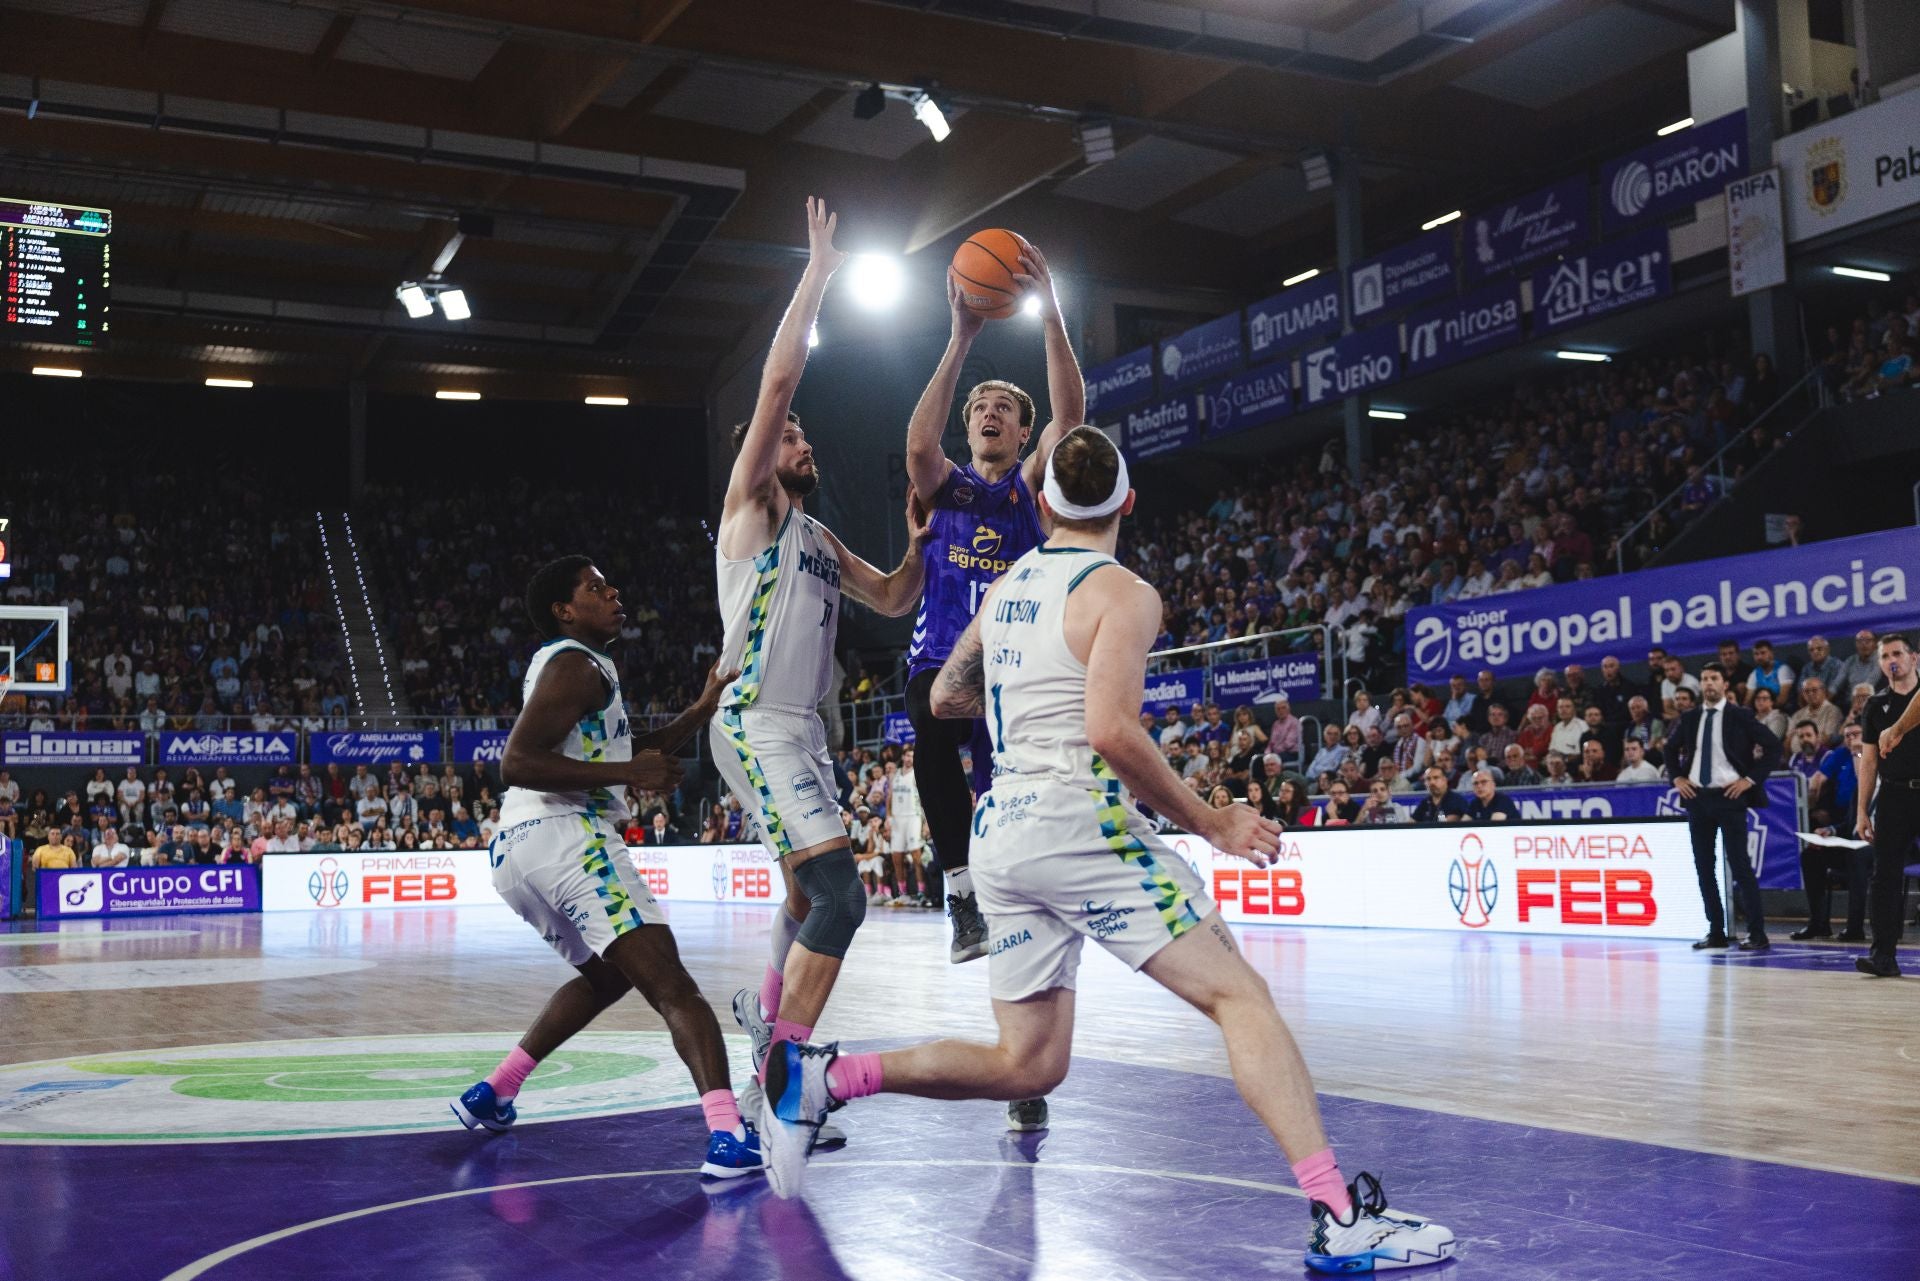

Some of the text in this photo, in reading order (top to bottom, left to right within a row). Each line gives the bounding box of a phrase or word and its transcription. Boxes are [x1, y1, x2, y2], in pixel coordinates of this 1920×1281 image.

[1655, 143, 1739, 197] BARON
[1729, 175, 1776, 203] RIFA
[1445, 300, 1517, 342] nirosa
[1457, 609, 1508, 630] súper
[1459, 560, 1908, 665] agropal palencia
[5, 734, 141, 755] clomar
[359, 733, 424, 743] AMBULANCIAS
[1514, 835, 1653, 859] PRIMERA
[362, 857, 456, 871] PRIMERA
[108, 869, 243, 899] Grupo CFI
[363, 874, 457, 903] FEB
[639, 868, 669, 895] EB
[732, 868, 771, 898] FEB
[1213, 869, 1306, 916] FEB
[1516, 869, 1657, 926] FEB
